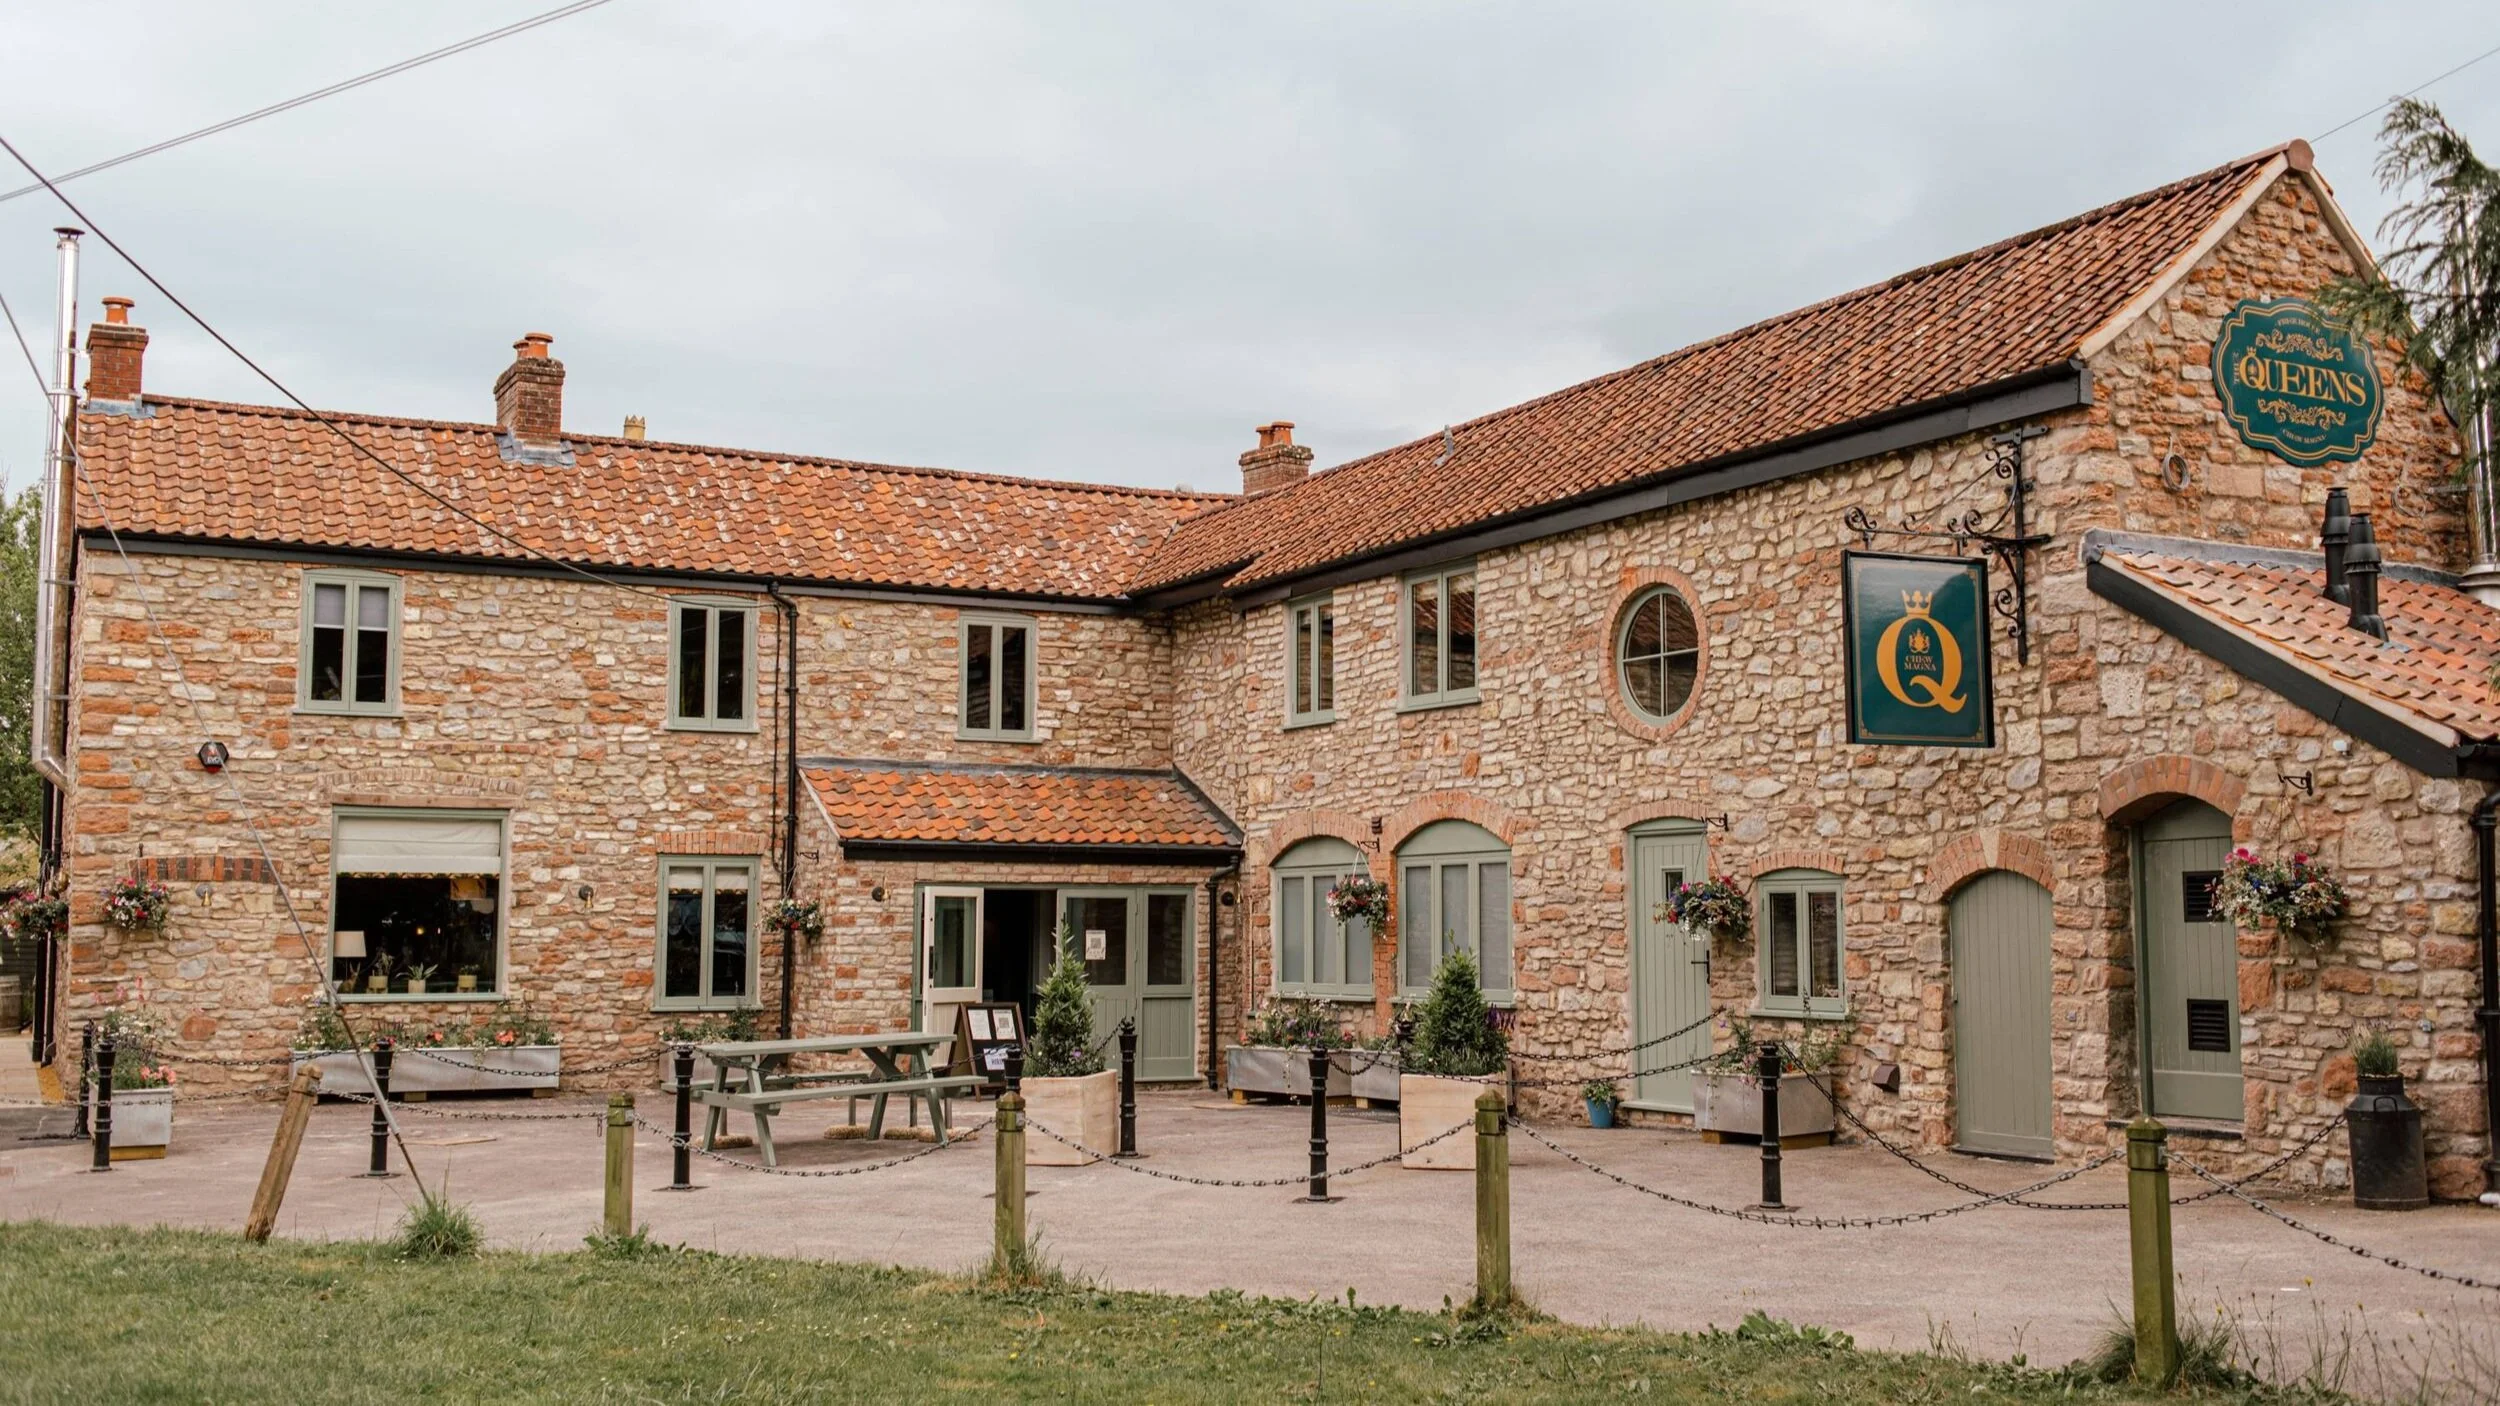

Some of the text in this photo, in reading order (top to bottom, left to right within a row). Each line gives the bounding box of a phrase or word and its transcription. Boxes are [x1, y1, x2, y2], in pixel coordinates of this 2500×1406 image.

[2239, 354, 2367, 407] QUEENS
[1876, 615, 1968, 714] Q
[1904, 662, 1937, 671] MAGNA
[1905, 655, 1934, 663] CHEW
